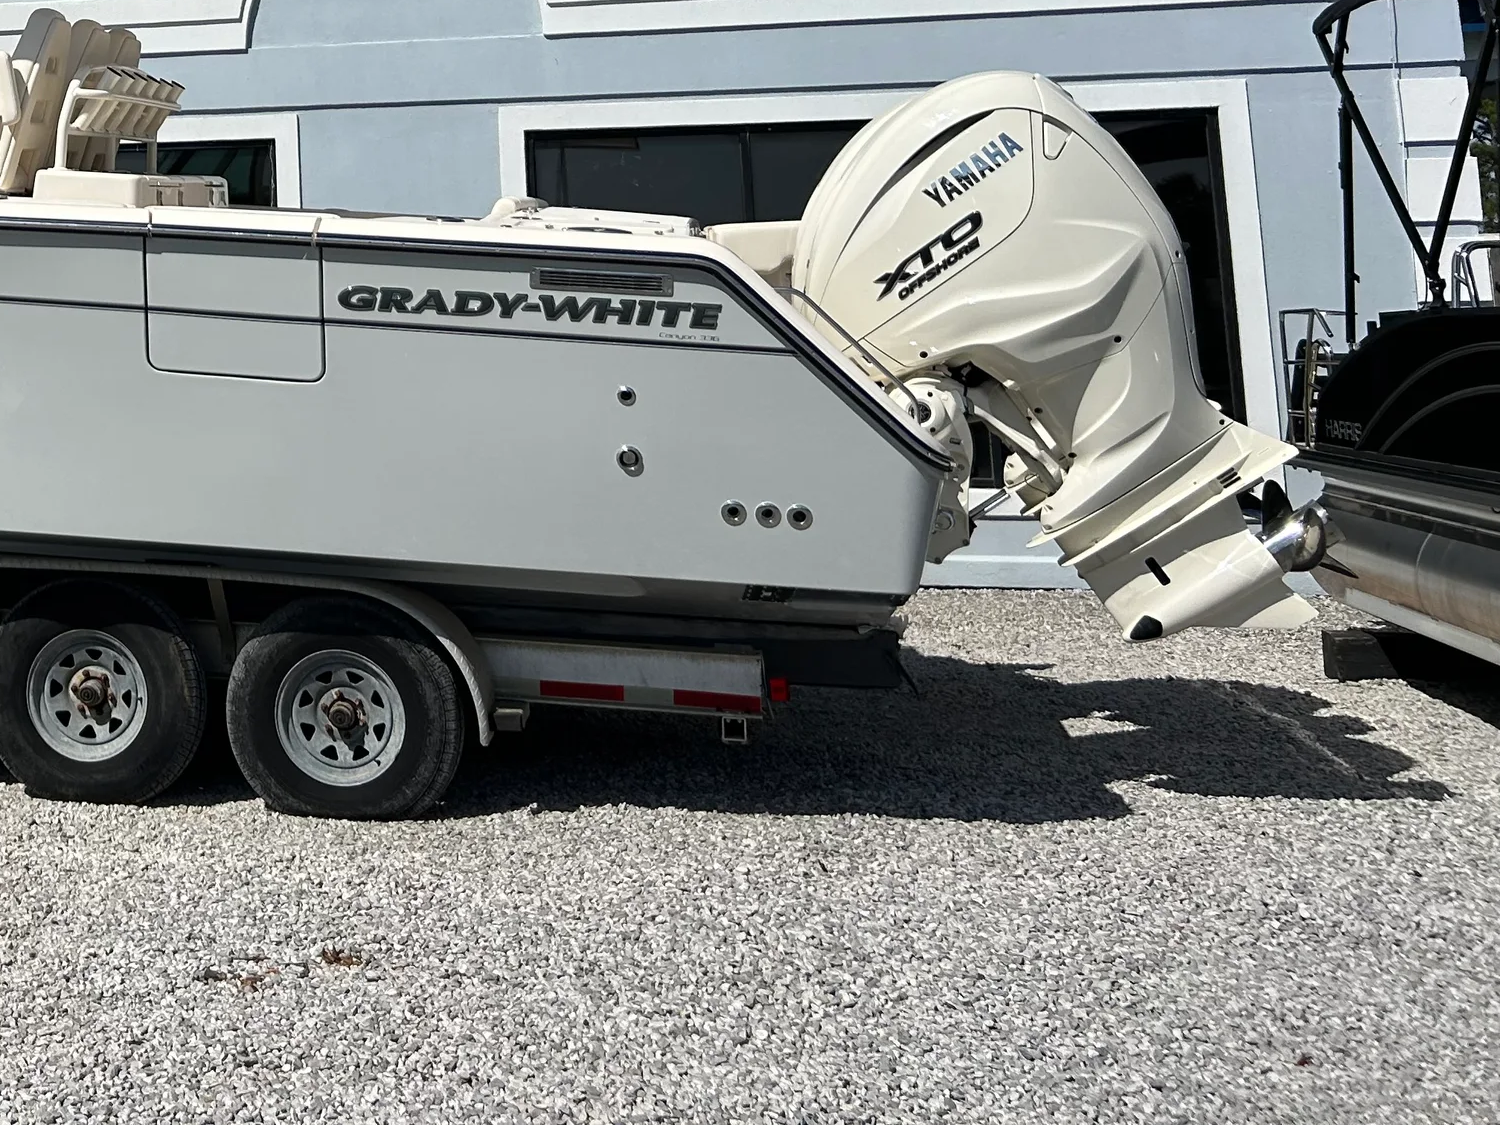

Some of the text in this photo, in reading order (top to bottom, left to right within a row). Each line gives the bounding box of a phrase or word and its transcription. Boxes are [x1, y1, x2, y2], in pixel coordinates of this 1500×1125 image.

[922, 132, 1024, 208] YAMAHA
[873, 211, 984, 302] XTO
[898, 236, 981, 301] OFFSHORE
[337, 285, 722, 330] GRADY-WHITE
[659, 331, 697, 341] Canyon
[1324, 419, 1362, 442] HARRIS
